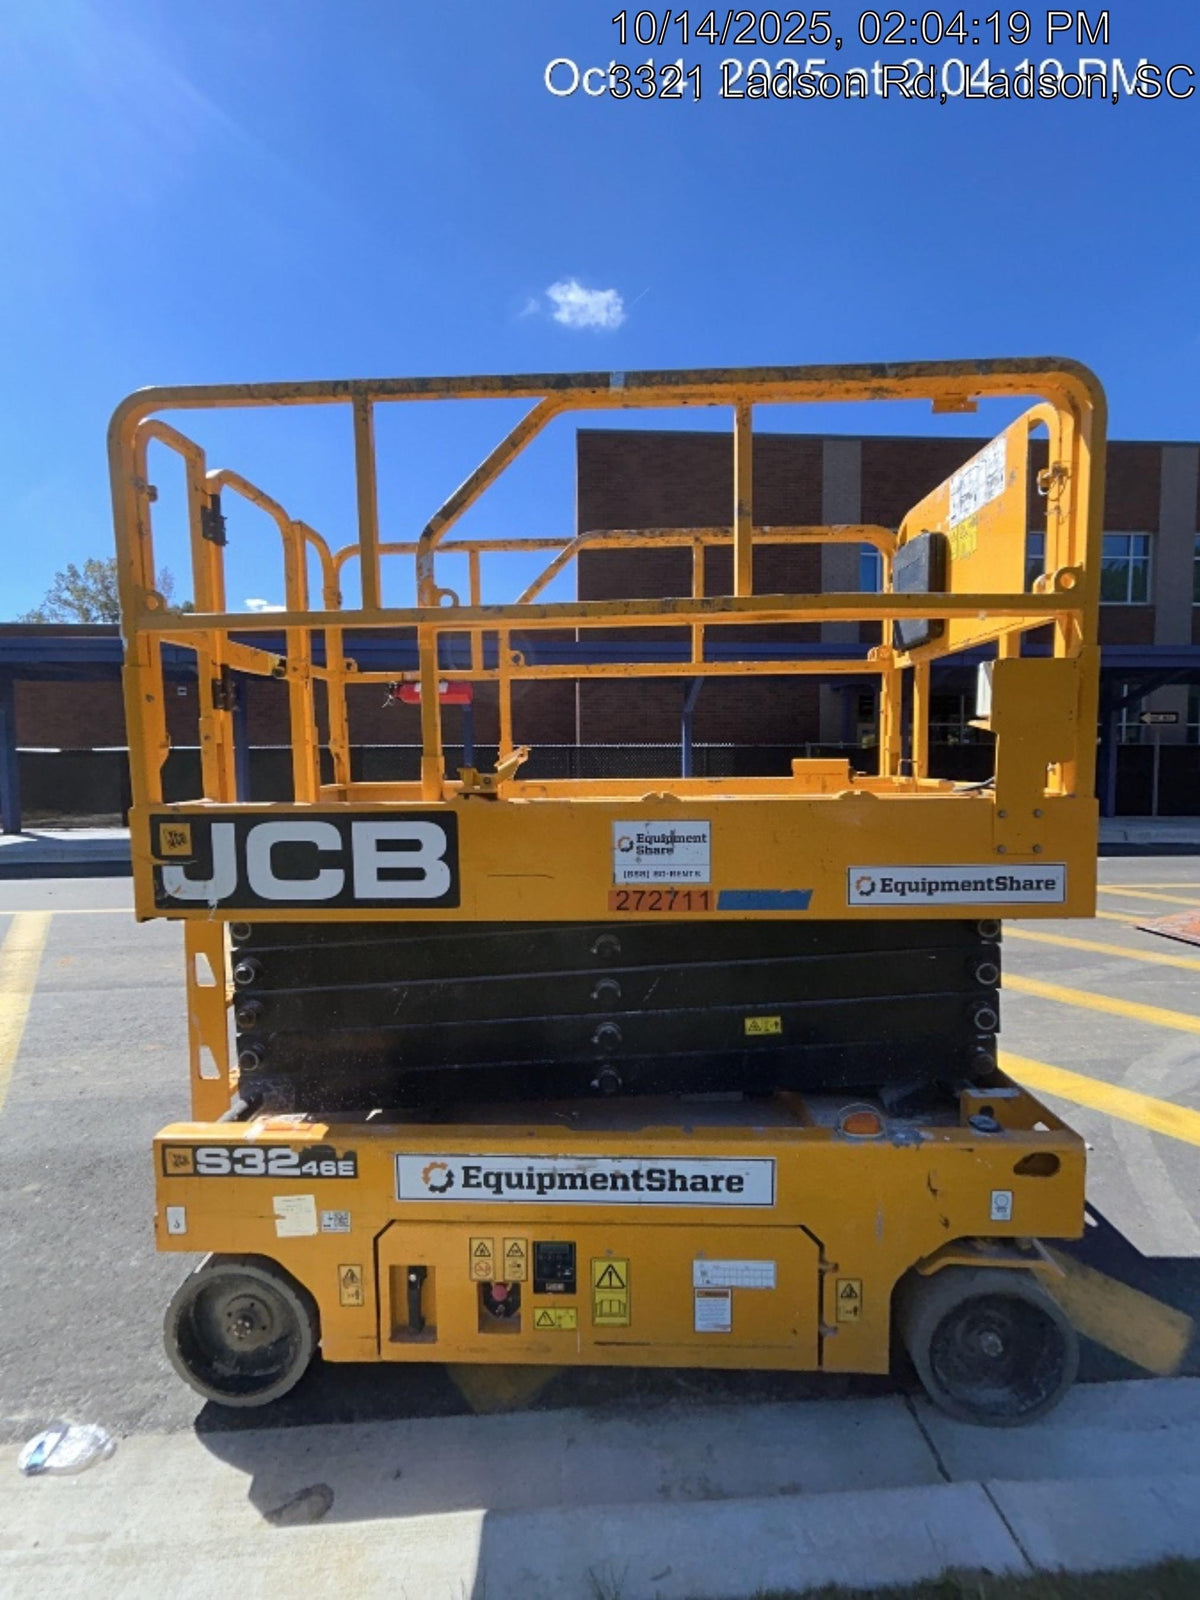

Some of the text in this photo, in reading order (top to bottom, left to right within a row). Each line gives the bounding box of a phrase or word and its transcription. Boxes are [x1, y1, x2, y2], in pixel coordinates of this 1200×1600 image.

[635, 832, 708, 846] Equipment
[161, 820, 452, 901] JCB
[635, 845, 675, 856] Share
[880, 876, 1057, 897] EquipmentShare
[616, 889, 710, 912] 272711
[461, 1165, 745, 1195] EquipmentShare
